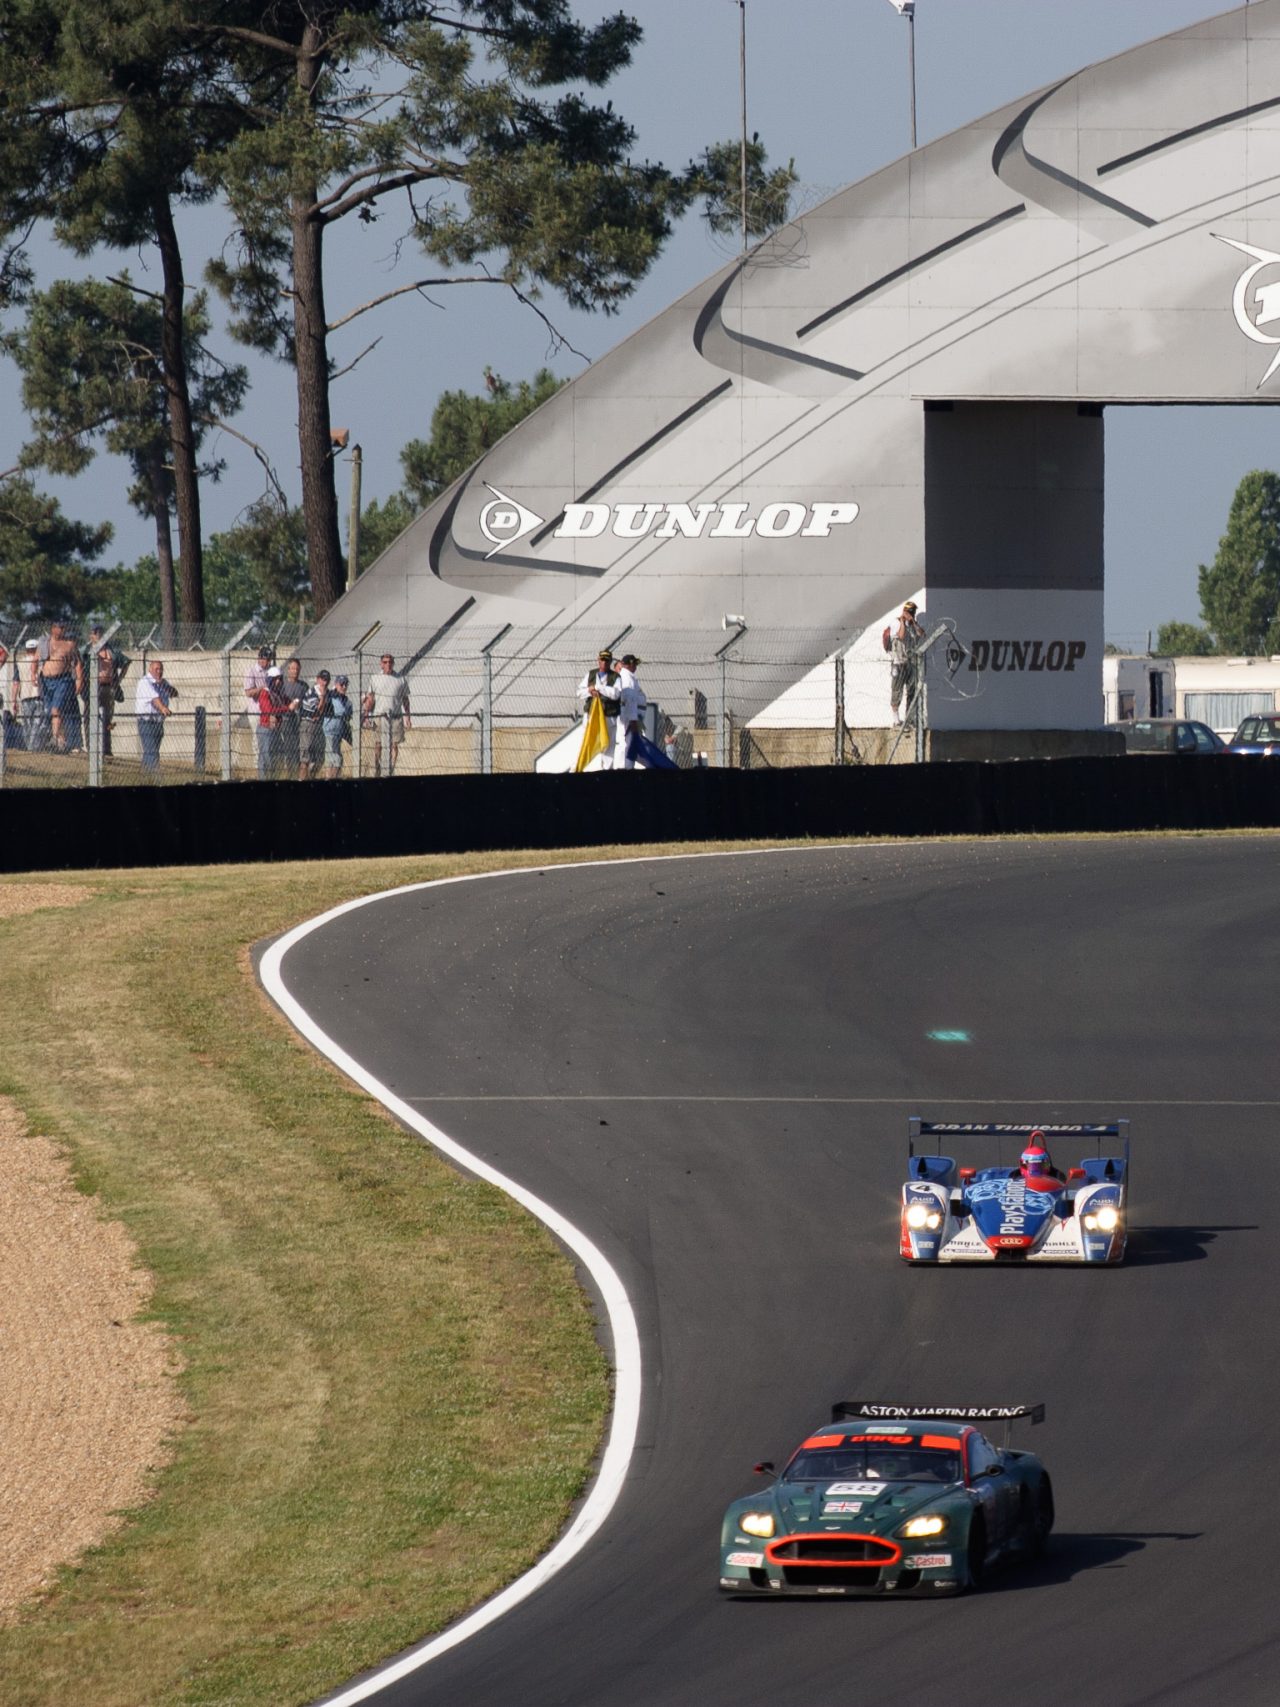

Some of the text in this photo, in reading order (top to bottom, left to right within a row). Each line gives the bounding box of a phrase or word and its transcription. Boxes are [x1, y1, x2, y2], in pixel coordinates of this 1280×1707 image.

[553, 501, 859, 539] DUNLOP
[968, 639, 1087, 672] DUNLOP
[1000, 1178, 1027, 1234] PlayStation
[859, 1405, 1026, 1417] ASTON MARTIN RACING
[832, 1484, 877, 1492] 58
[915, 1556, 946, 1567] Castrol
